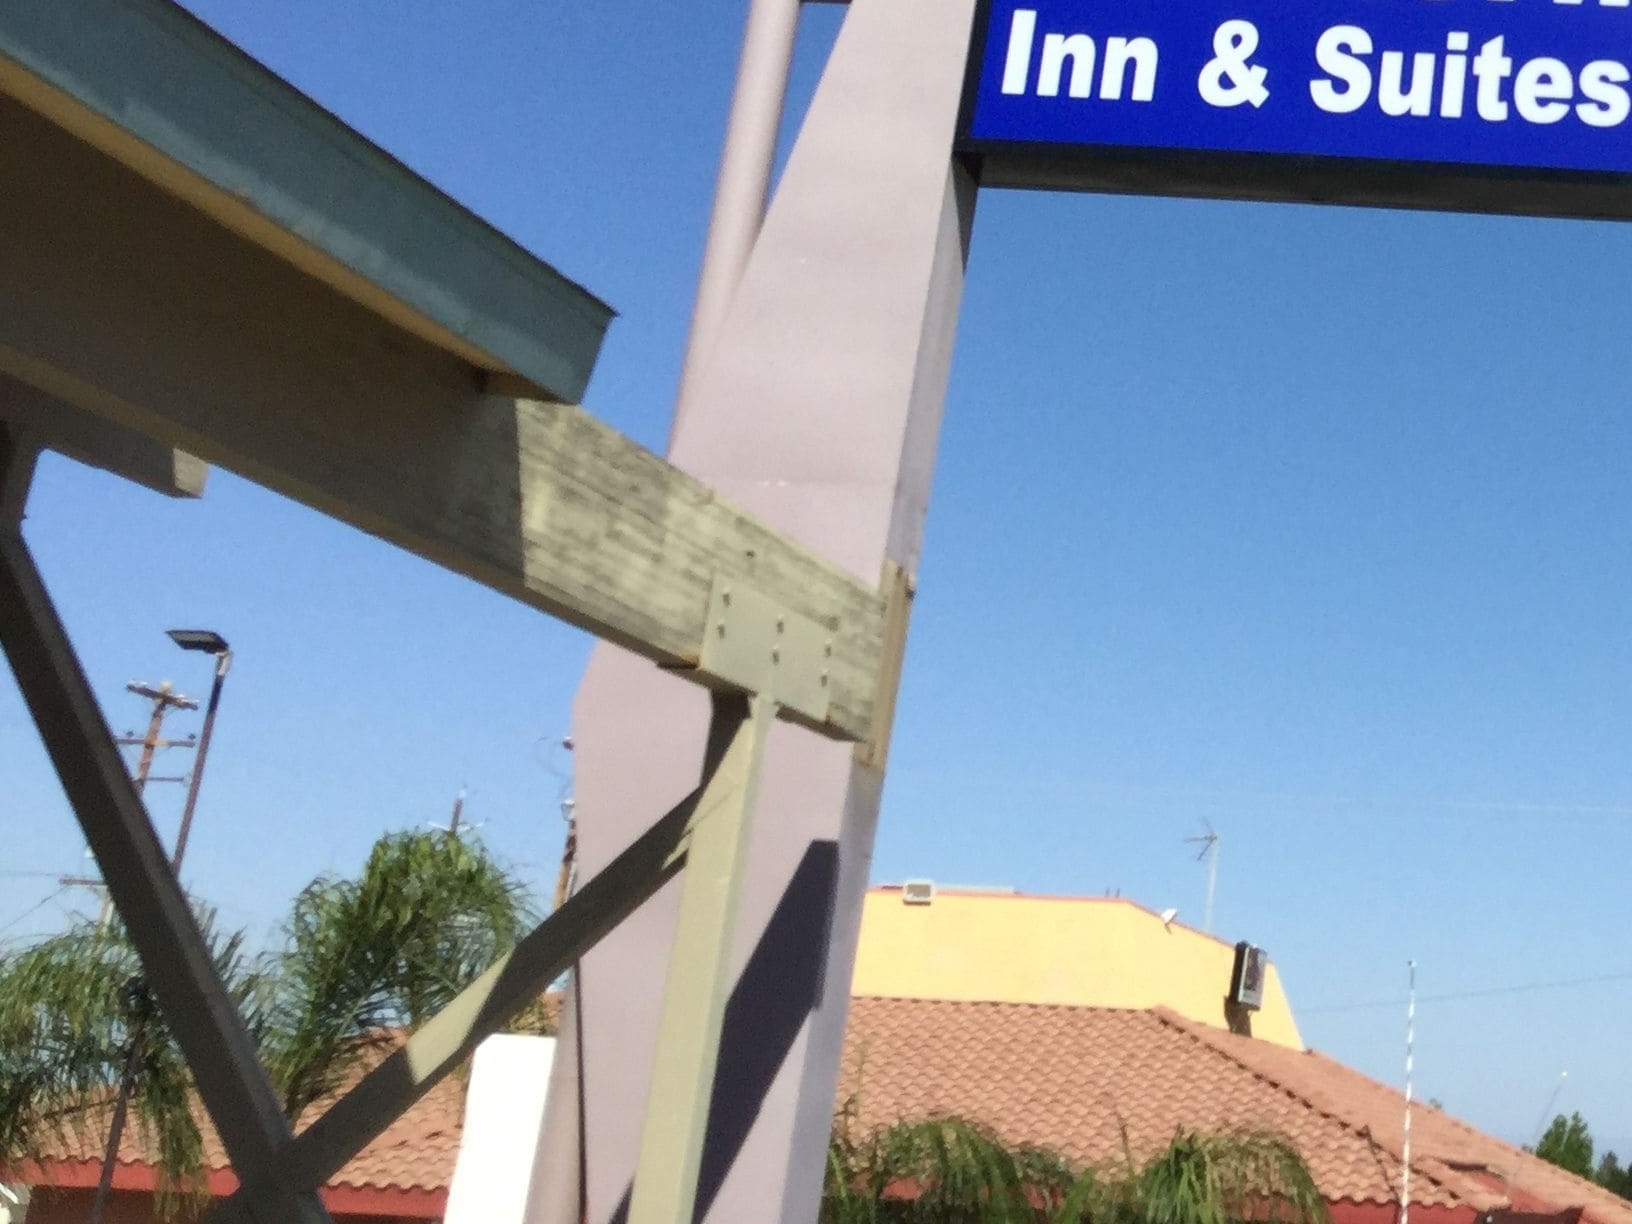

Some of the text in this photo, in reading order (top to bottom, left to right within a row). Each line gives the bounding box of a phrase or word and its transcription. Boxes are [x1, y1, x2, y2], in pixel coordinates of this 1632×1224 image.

[1001, 9, 1631, 127] Inn & Suites
